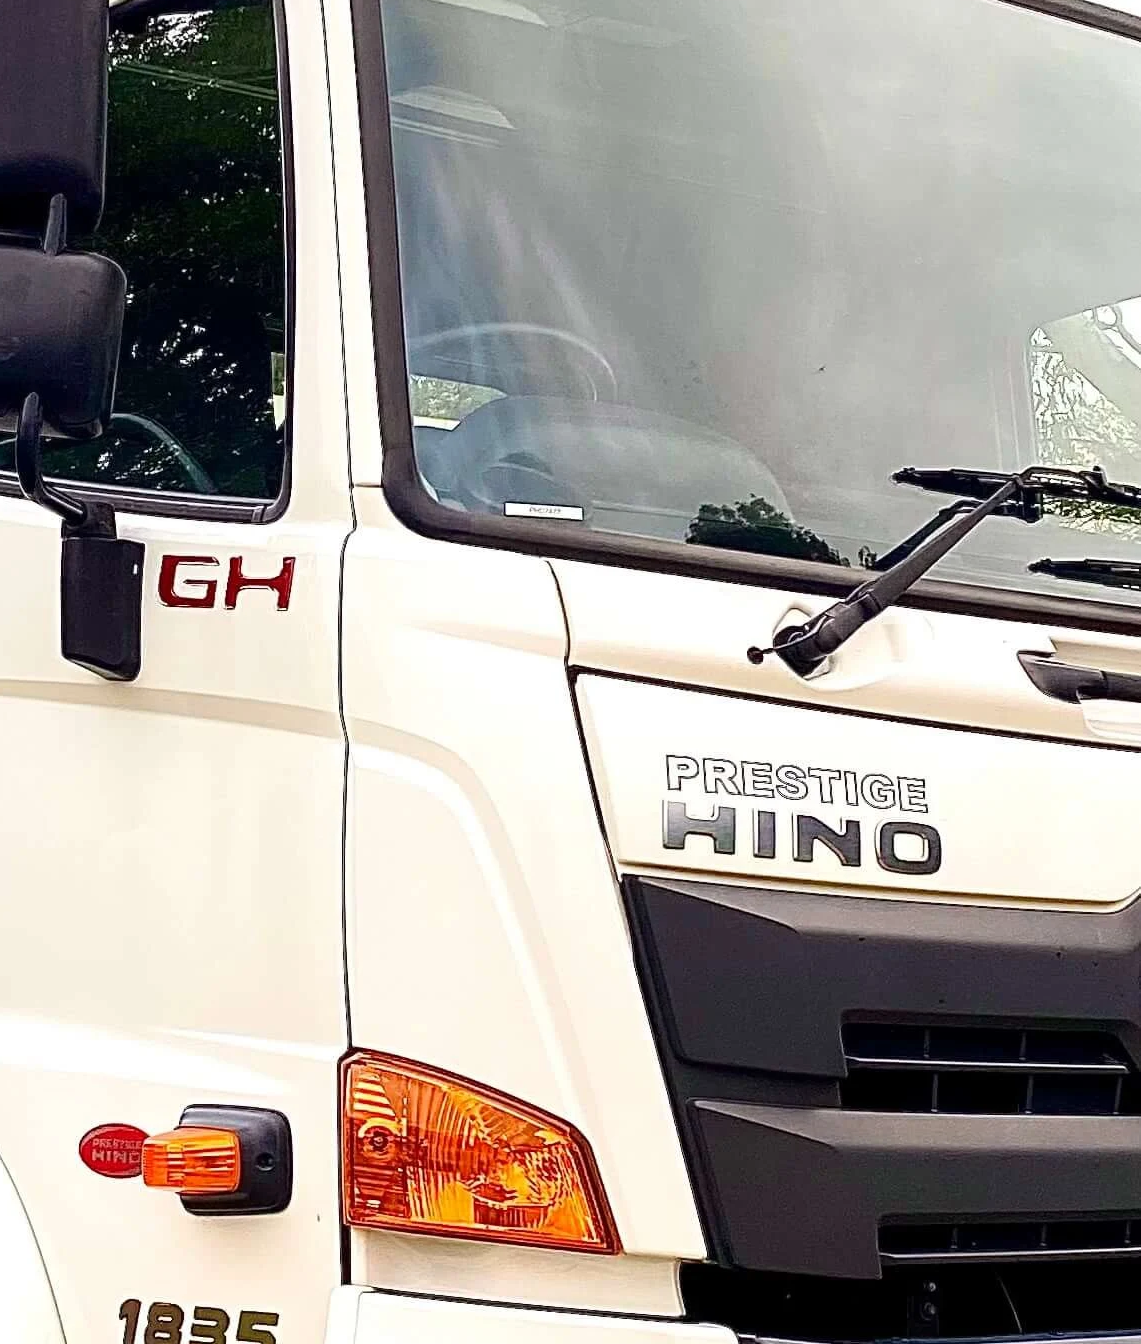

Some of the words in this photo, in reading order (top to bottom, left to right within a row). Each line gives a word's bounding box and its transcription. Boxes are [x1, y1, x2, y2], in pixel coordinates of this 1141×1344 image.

[158, 555, 296, 611] GH
[666, 755, 928, 813] PRESTIGE
[662, 800, 941, 875] HINO
[91, 1149, 141, 1164] HINO
